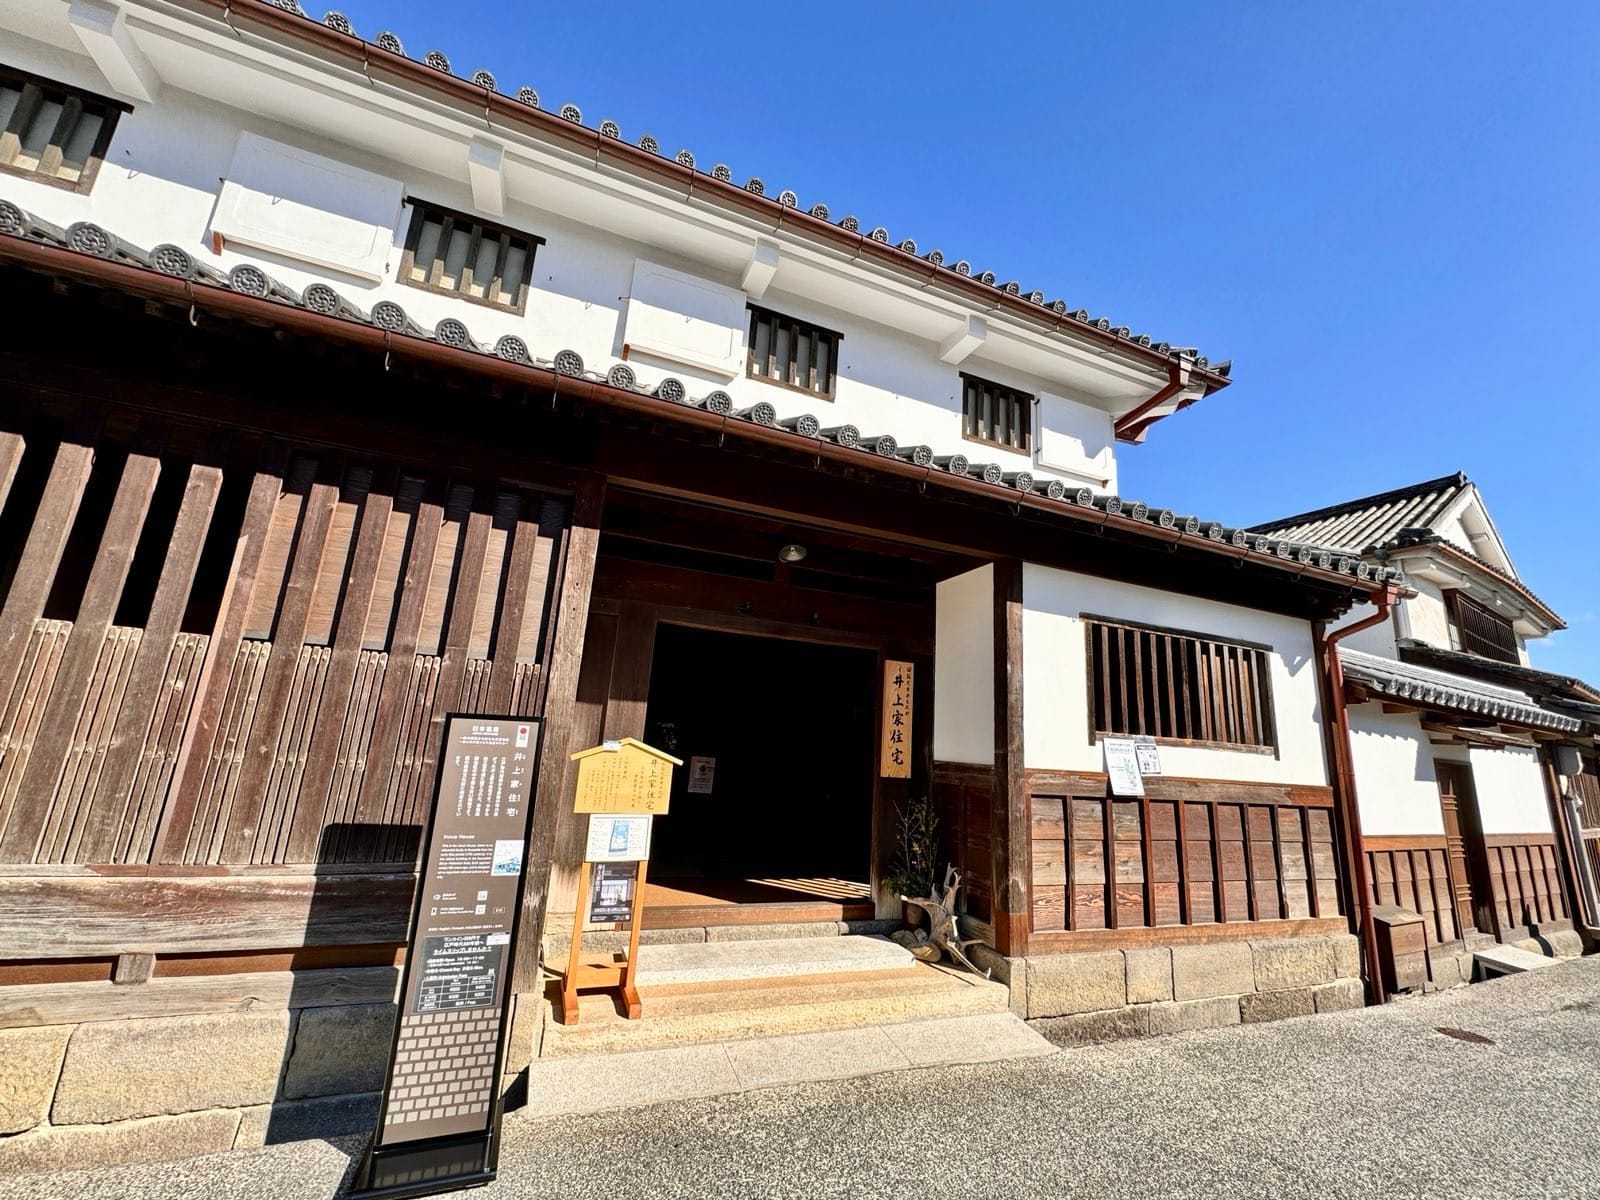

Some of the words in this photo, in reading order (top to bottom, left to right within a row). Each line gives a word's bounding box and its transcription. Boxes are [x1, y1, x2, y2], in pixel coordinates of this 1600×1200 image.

[890, 673, 905, 766] 井上家住宅
[506, 752, 522, 817] 井上家住宅
[645, 759, 658, 811] 井上家住宅
